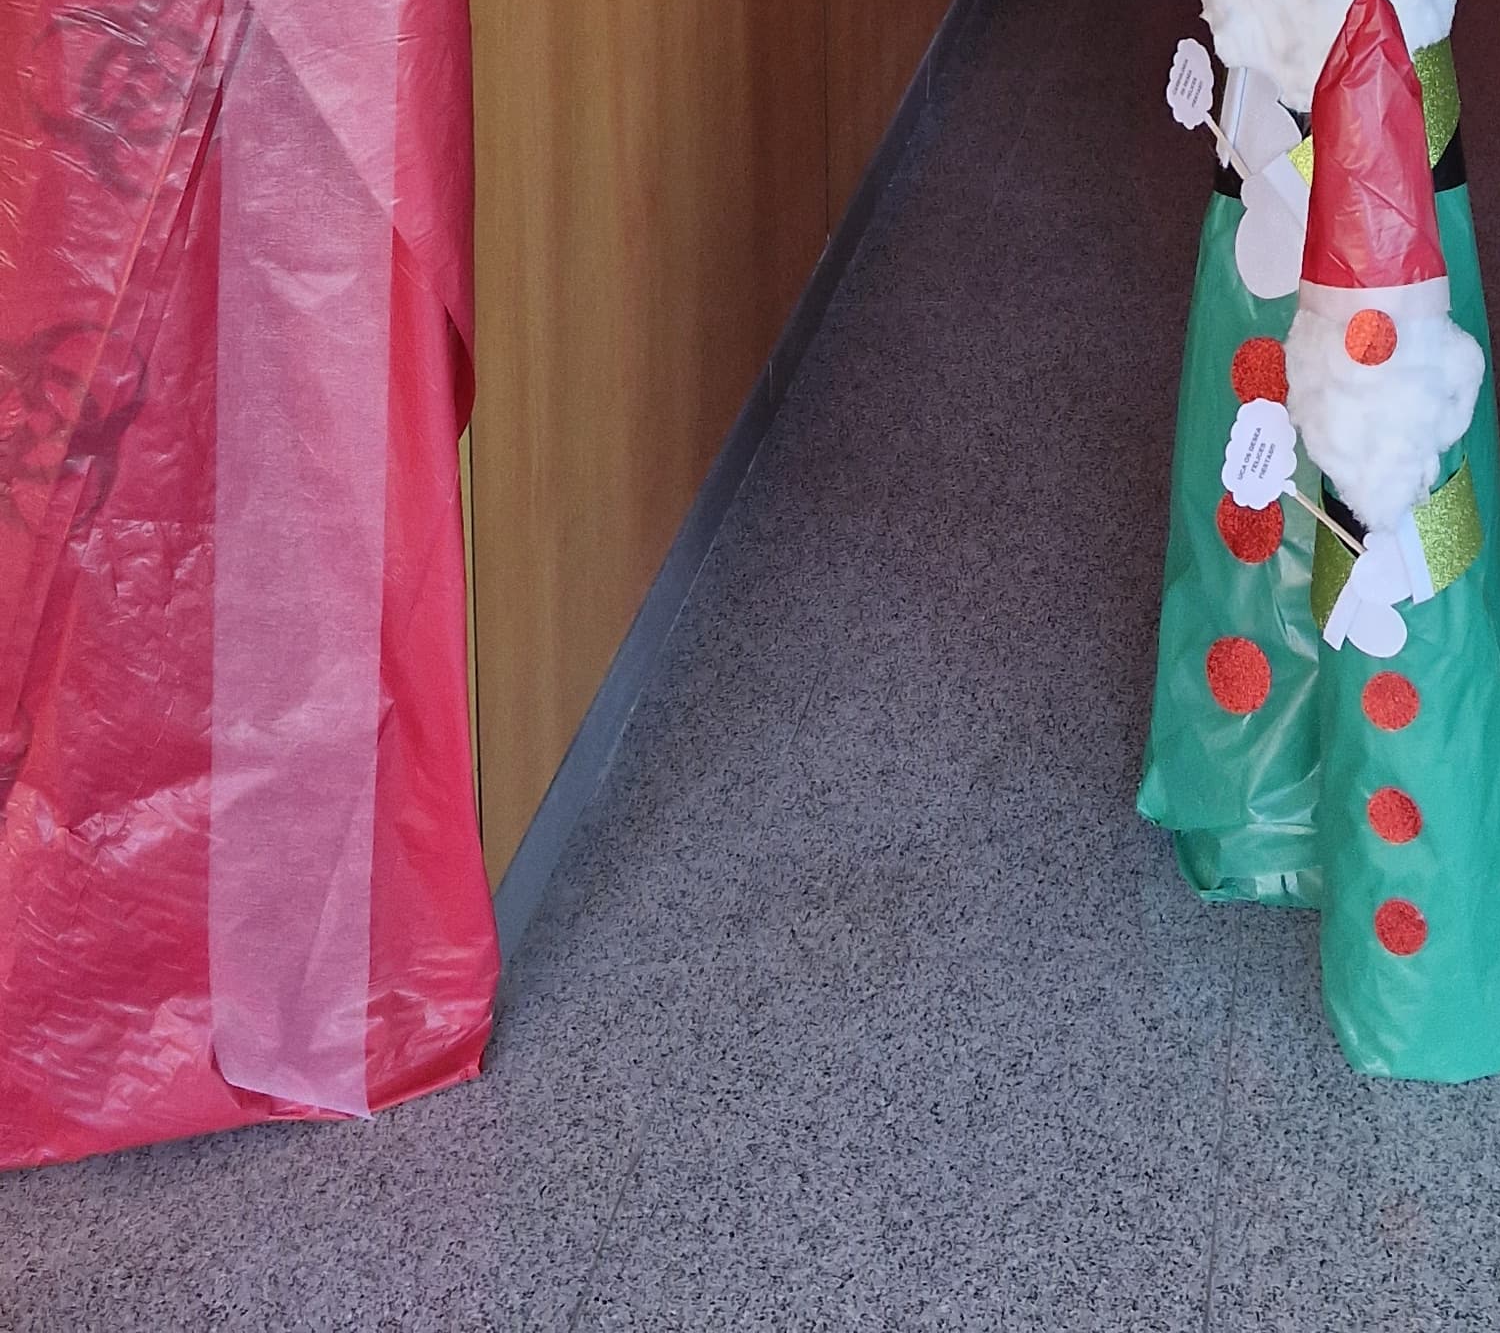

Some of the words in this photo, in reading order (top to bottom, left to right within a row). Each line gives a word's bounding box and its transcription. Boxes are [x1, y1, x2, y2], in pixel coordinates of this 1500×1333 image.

[1244, 452, 1251, 463] OS
[1249, 427, 1261, 451] DESEA
[1251, 442, 1266, 472] FELICES
